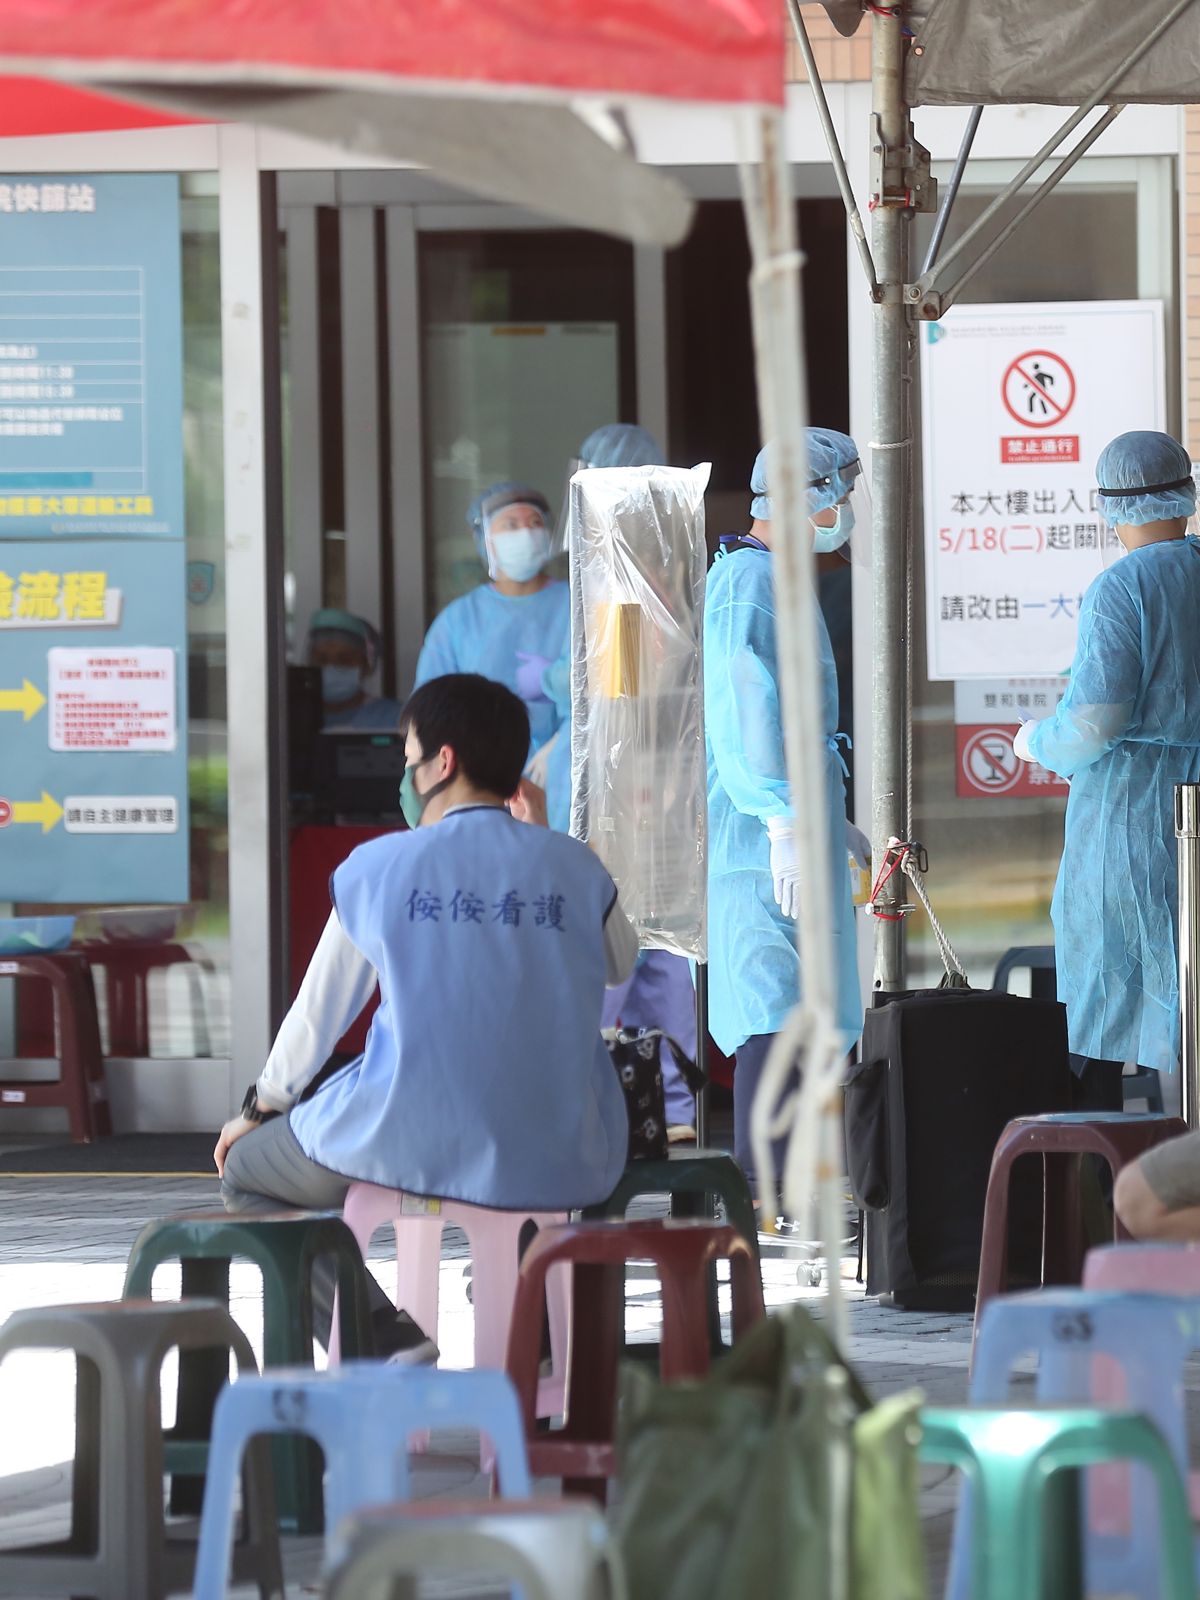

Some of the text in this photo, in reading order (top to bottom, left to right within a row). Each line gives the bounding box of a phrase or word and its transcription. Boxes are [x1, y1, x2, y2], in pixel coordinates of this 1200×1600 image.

[941, 593, 1083, 620] 請改由一大
